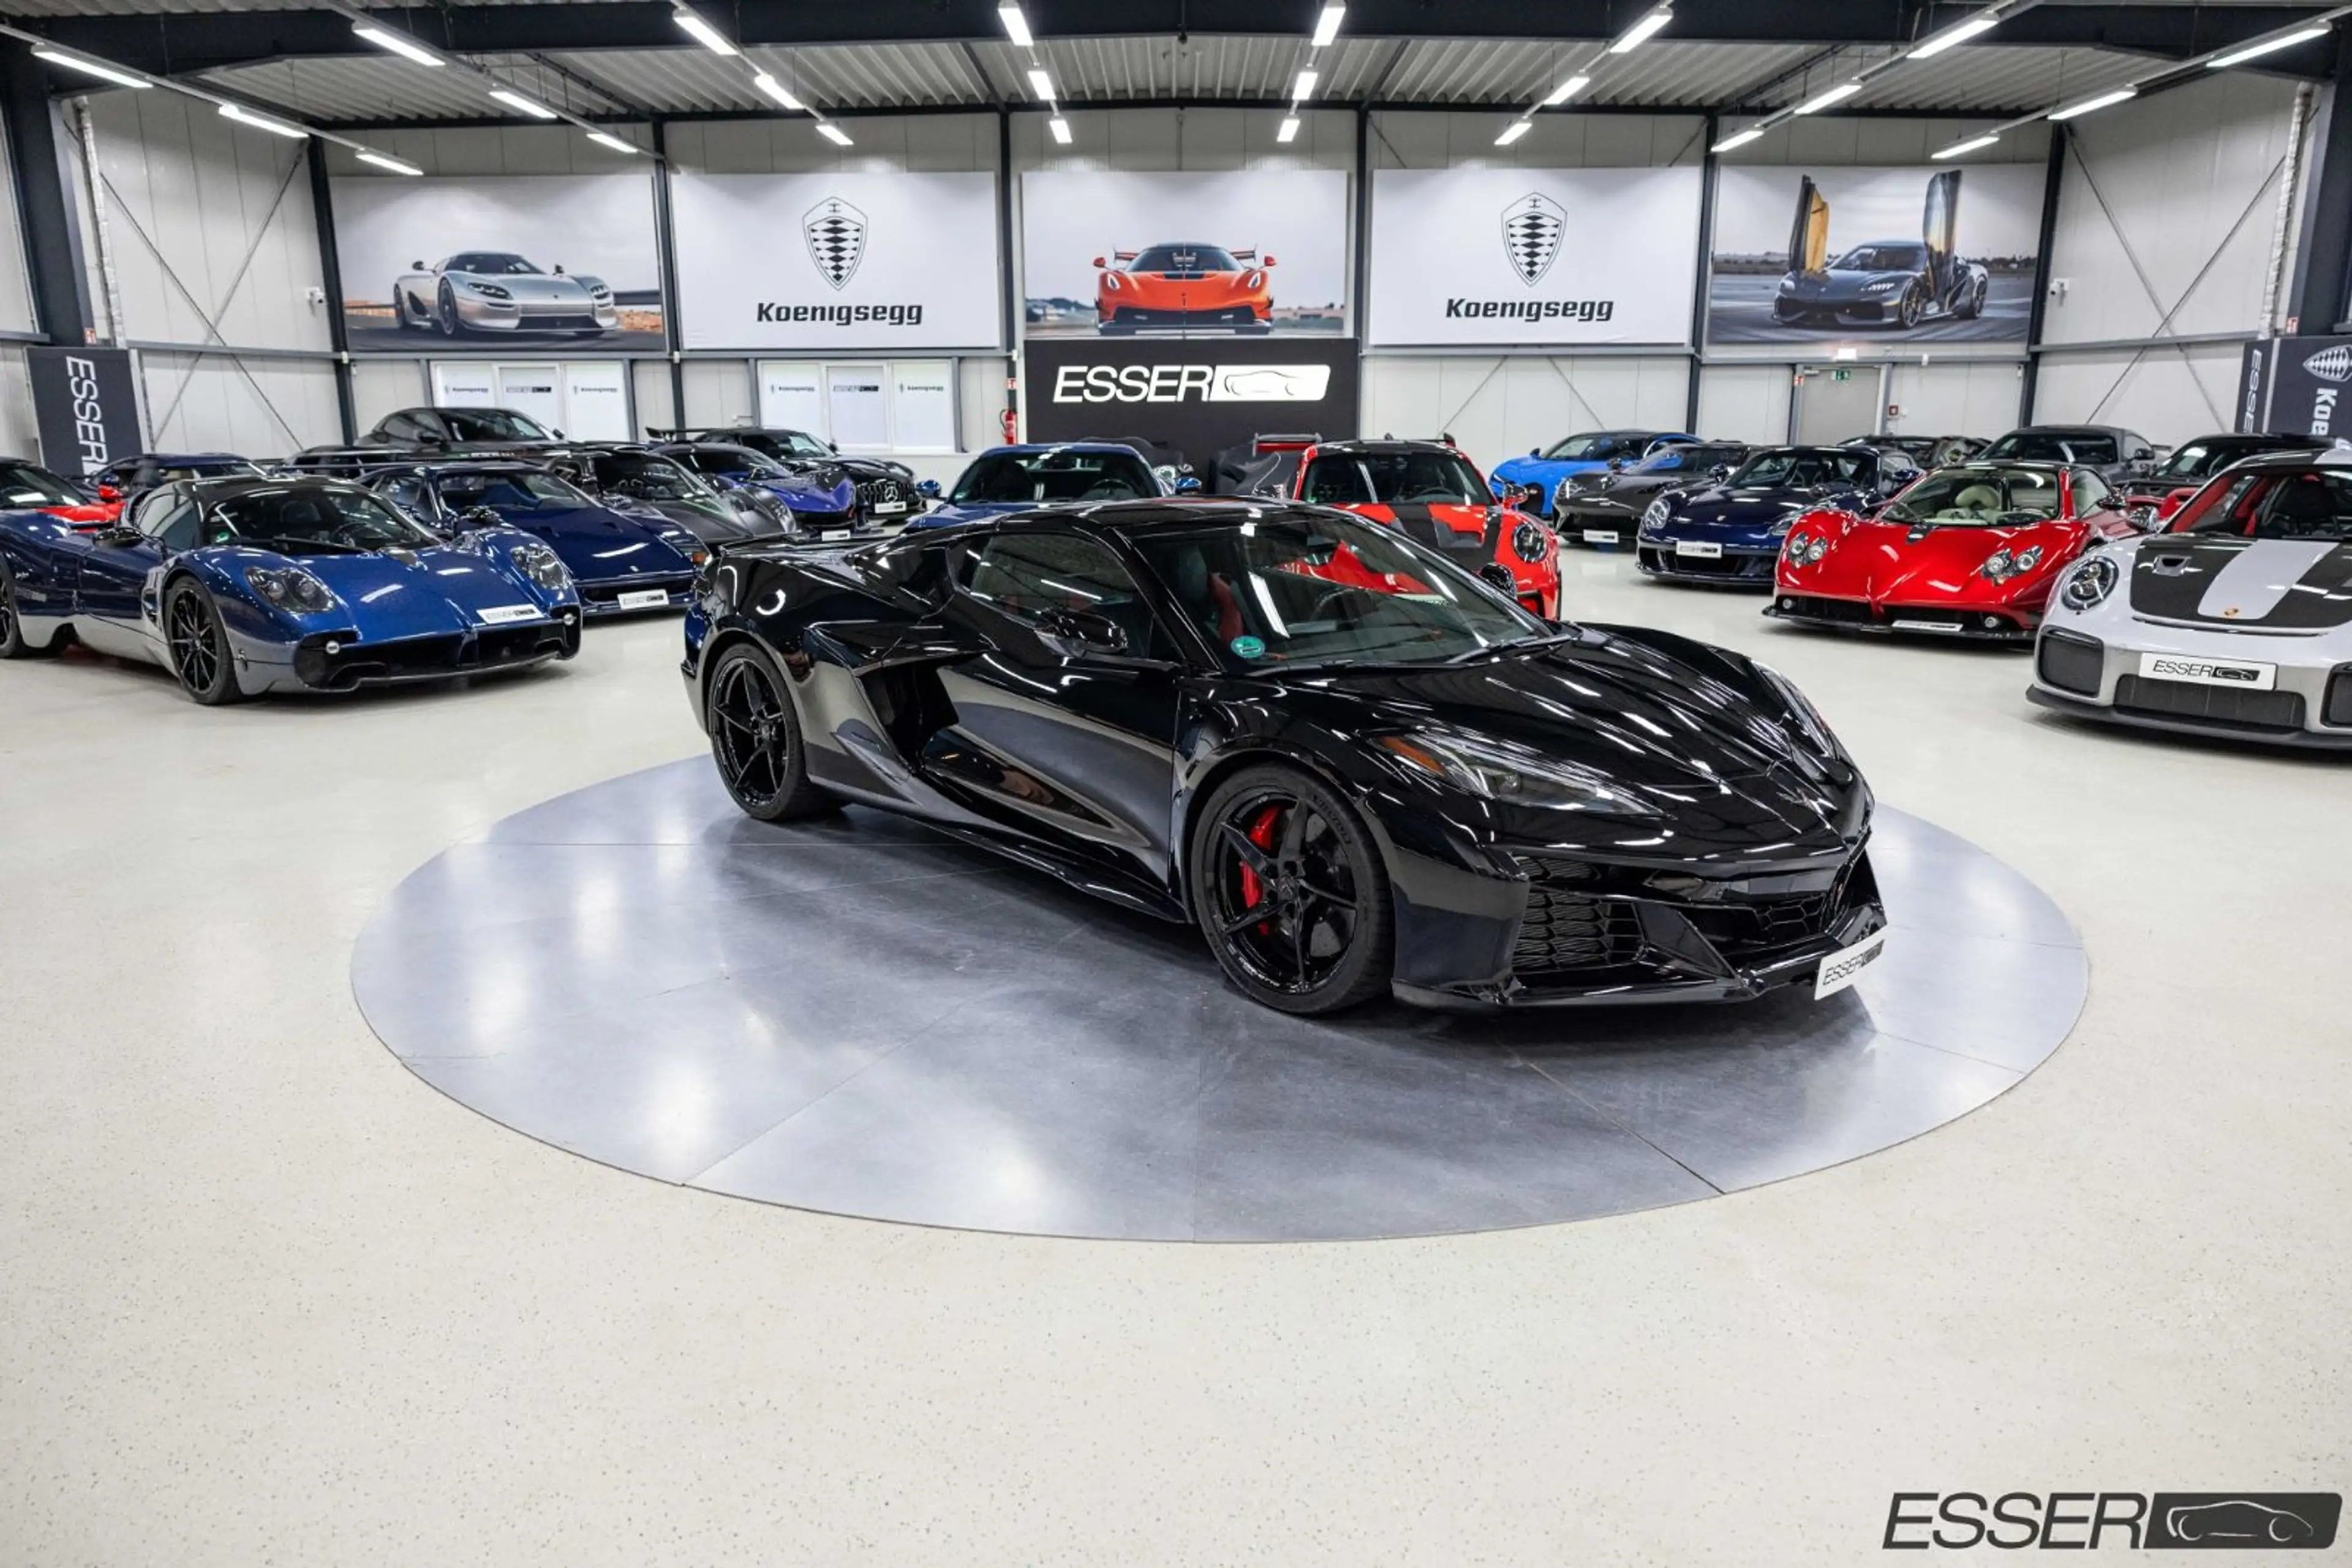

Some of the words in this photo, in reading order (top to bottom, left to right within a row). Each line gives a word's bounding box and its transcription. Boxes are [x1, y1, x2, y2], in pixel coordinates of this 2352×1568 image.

[757, 303, 922, 326] Koenigsegg
[1446, 298, 1614, 322] Koenigsegg
[1053, 365, 1213, 403] ESSER
[66, 356, 108, 464] ESSER
[2153, 659, 2213, 678] ESSER
[1823, 953, 1864, 986] ESSER
